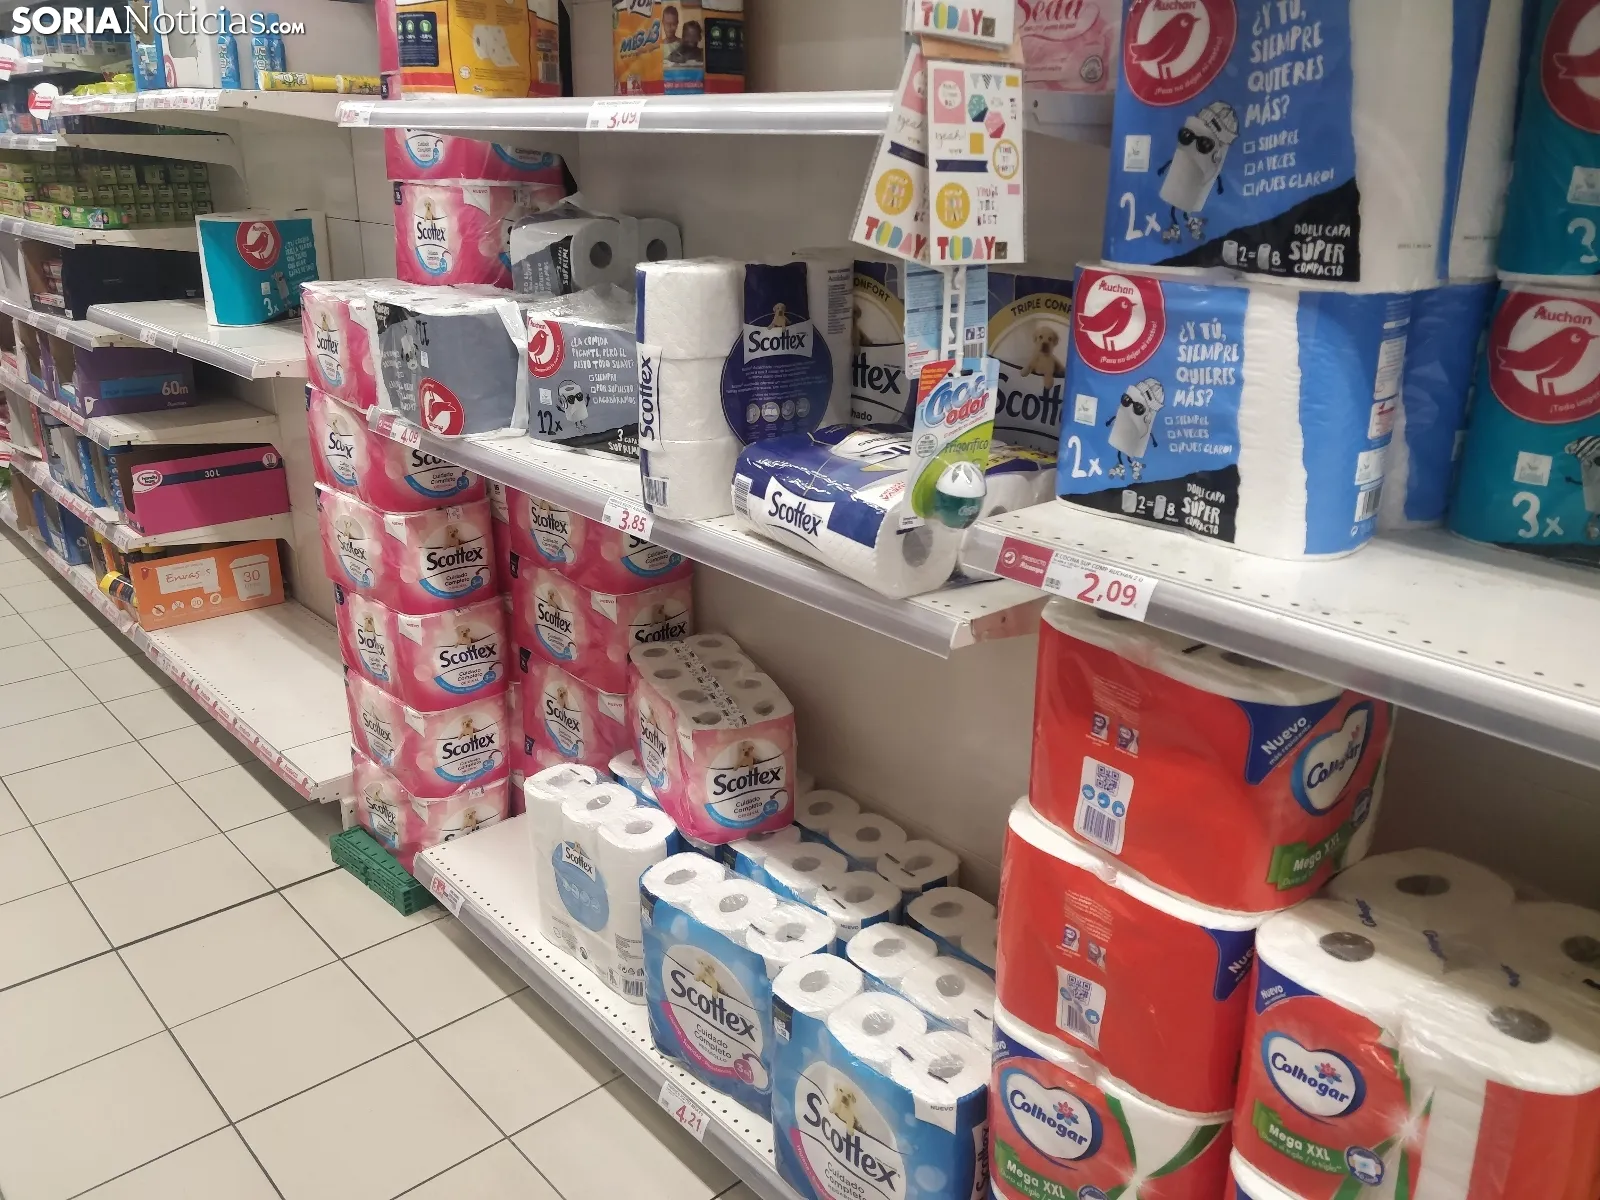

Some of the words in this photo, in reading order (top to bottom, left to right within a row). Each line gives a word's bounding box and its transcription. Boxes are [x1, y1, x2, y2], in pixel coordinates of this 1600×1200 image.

[921, 1, 983, 36] TODAY
[1249, 22, 1324, 64] SIEMPRE
[1247, 55, 1324, 95] QUIERES
[1244, 95, 1291, 128] MÁS?
[1258, 130, 1300, 151] SIEMPRE
[1265, 152, 1296, 171] VECES
[1120, 192, 1161, 241] 2x
[416, 222, 446, 242] Scottex
[864, 216, 927, 259] TODAY
[1325, 222, 1351, 237] CAPA
[936, 236, 996, 261] TODAY
[1288, 238, 1345, 264] SÚPER
[1294, 263, 1343, 276] COMPACTO
[853, 276, 891, 302] ONFORT
[1098, 280, 1134, 295] Auchan
[1010, 298, 1041, 317] TRIPLE
[1533, 305, 1593, 326] Auchan
[584, 336, 608, 346] COMIDA
[748, 329, 806, 353] Scottex
[1199, 317, 1227, 341] TÚ,
[316, 331, 339, 355] Scottex
[602, 347, 618, 357] PERO
[1177, 342, 1239, 364] SIEMPRE
[162, 380, 189, 396] 60m
[1176, 367, 1236, 386] QUIERES
[640, 355, 655, 442] Scottex
[1172, 385, 1213, 408] MÁS?
[537, 409, 563, 436] 12x
[616, 428, 624, 442] 3
[1068, 435, 1102, 478] 2x
[204, 470, 214, 478] 30
[1206, 490, 1226, 504] CAPA
[531, 507, 568, 534] Scottex
[619, 510, 646, 533] 3,85
[768, 491, 822, 537] Scottex
[1181, 496, 1221, 525] SÚPER
[1512, 490, 1564, 538] 3x
[1185, 516, 1219, 535] COMPACTO
[426, 547, 484, 571] Scottex
[243, 569, 261, 583] 30
[1077, 572, 1137, 607] 2,09
[537, 603, 572, 633] Scottex
[634, 621, 687, 643] Scottex
[440, 643, 497, 668] Scottex
[441, 733, 496, 760] Scottex
[1261, 716, 1308, 755] Nuevo
[713, 766, 781, 796] Scottex
[733, 802, 763, 814] Completo
[735, 796, 760, 808] Cuidado
[565, 847, 593, 875] Scottex
[1293, 850, 1322, 872] Mega
[1261, 985, 1284, 999] Nuevo
[670, 969, 756, 1043] Scottex
[694, 1030, 732, 1060] Completo
[695, 1023, 728, 1050] Cuidado
[1271, 1052, 1349, 1103] Colhogar
[675, 1104, 701, 1133] 4,21
[930, 1104, 954, 1112] NUEVO
[1009, 1089, 1088, 1146] Colhogar
[803, 1092, 900, 1192] Scottex
[1269, 1124, 1303, 1151] Mega
[1306, 1144, 1331, 1162] XXL
[827, 1161, 865, 1195] Cuidado
[1006, 1159, 1039, 1187] Mega
[1043, 1180, 1066, 1199] XXL
